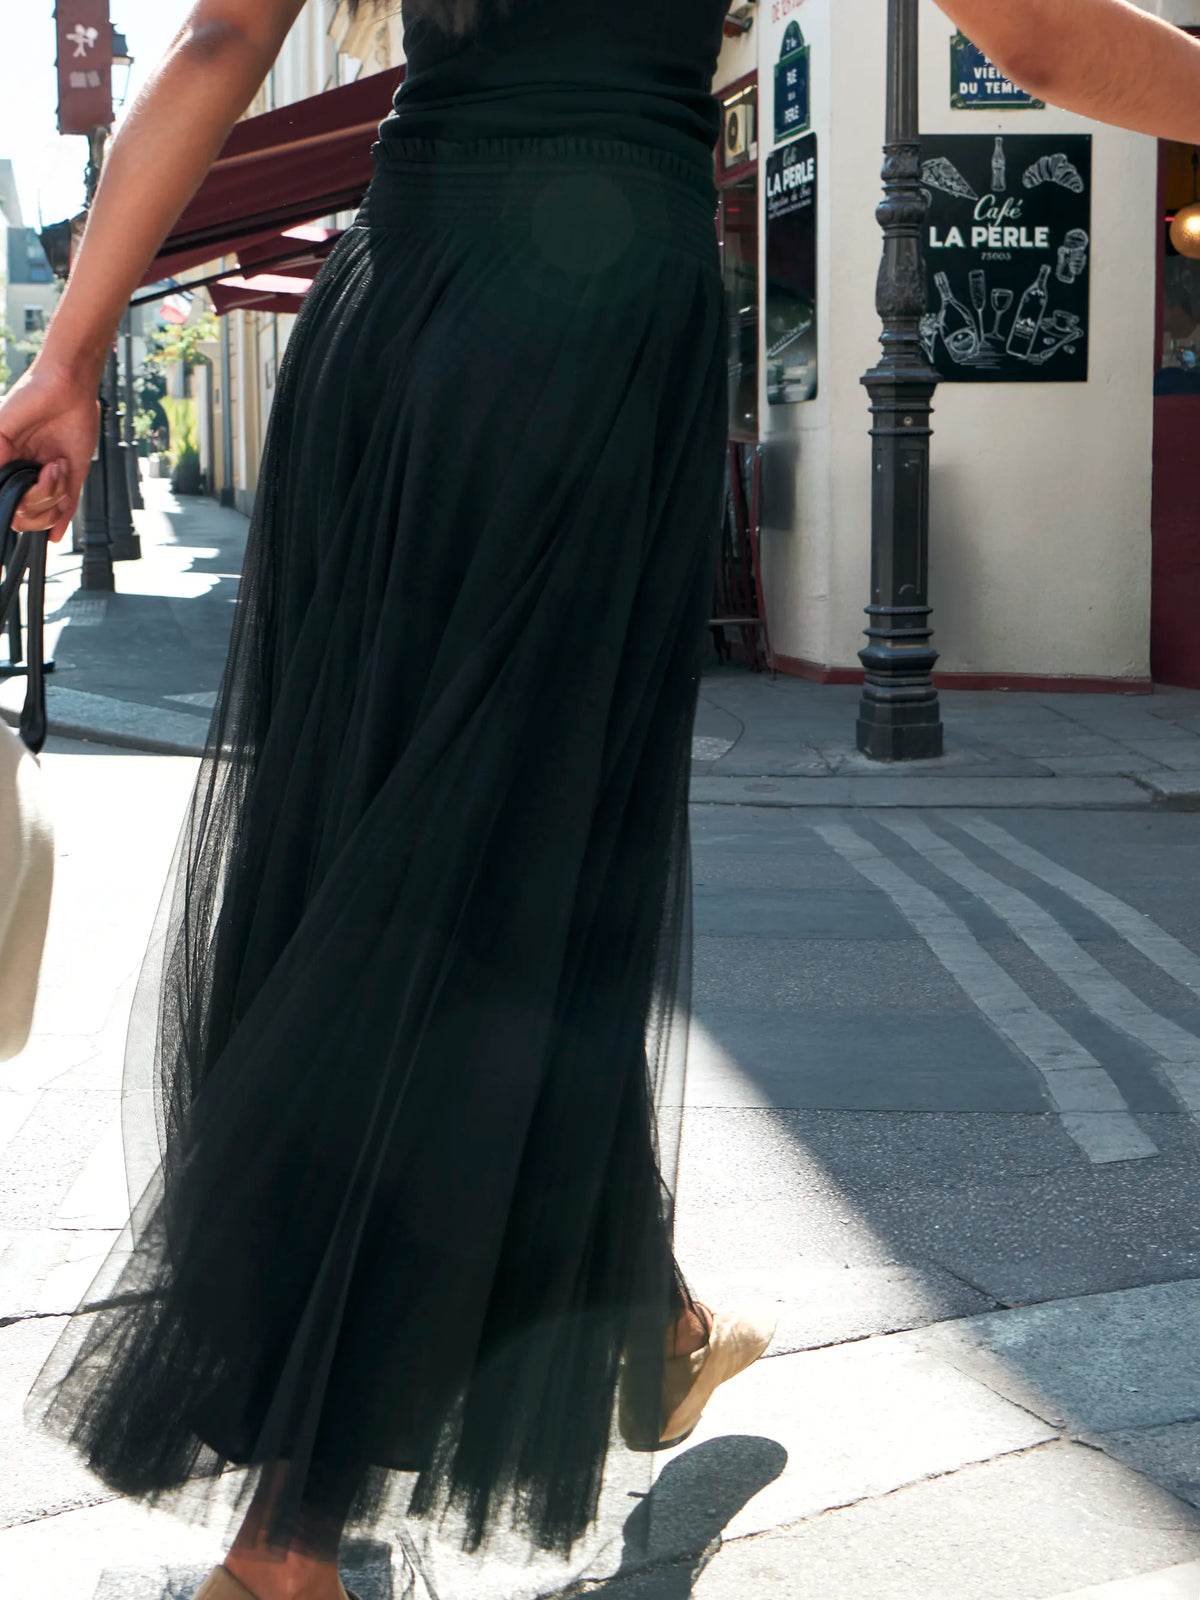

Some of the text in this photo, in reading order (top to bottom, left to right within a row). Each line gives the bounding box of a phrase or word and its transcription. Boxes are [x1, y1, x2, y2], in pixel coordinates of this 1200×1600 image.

[960, 82, 1029, 94] DU TEMP
[767, 157, 815, 197] LA PERLE
[973, 194, 1023, 227] Café
[929, 226, 1049, 248] LA PERLE
